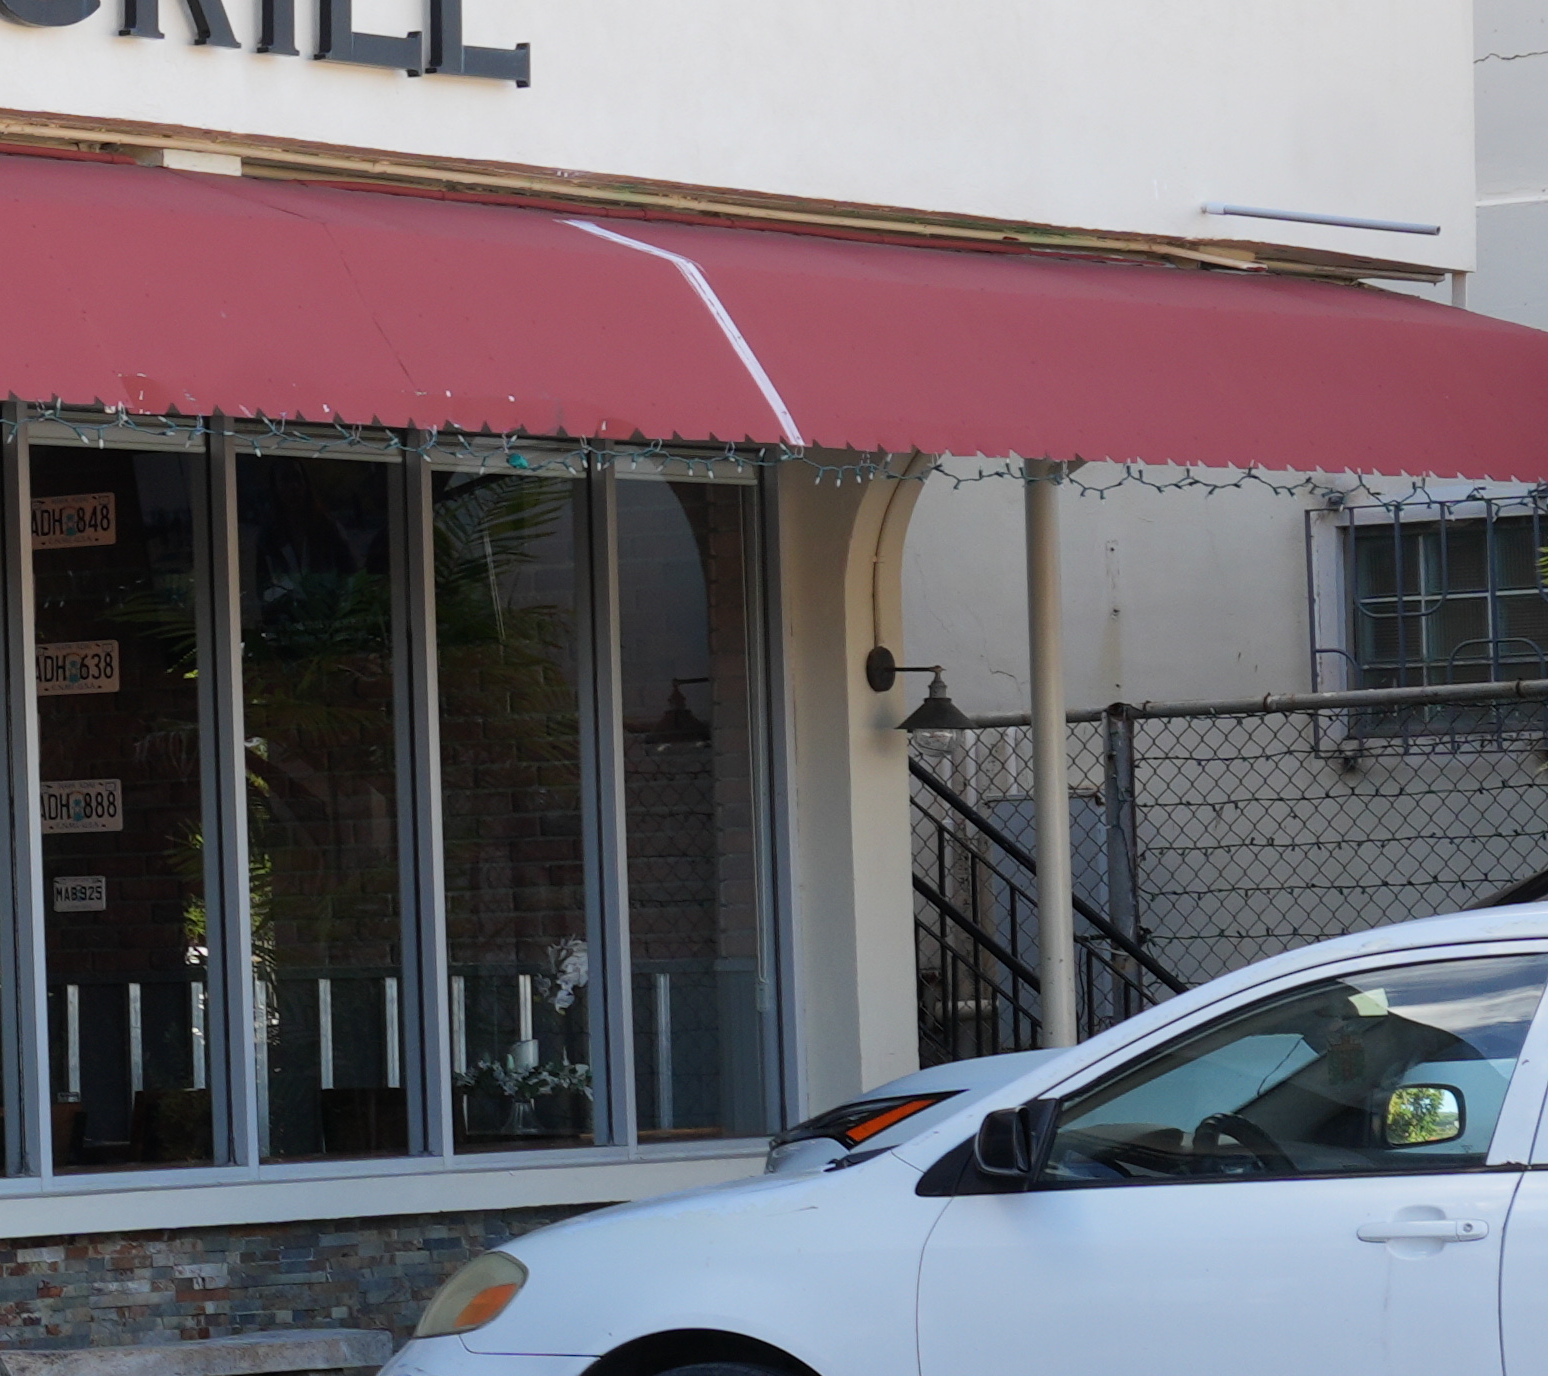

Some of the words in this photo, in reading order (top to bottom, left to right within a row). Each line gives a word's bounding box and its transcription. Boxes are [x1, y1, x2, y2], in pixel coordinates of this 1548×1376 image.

[76, 505, 110, 533] 848
[79, 652, 114, 680] 638
[83, 791, 117, 819] 888
